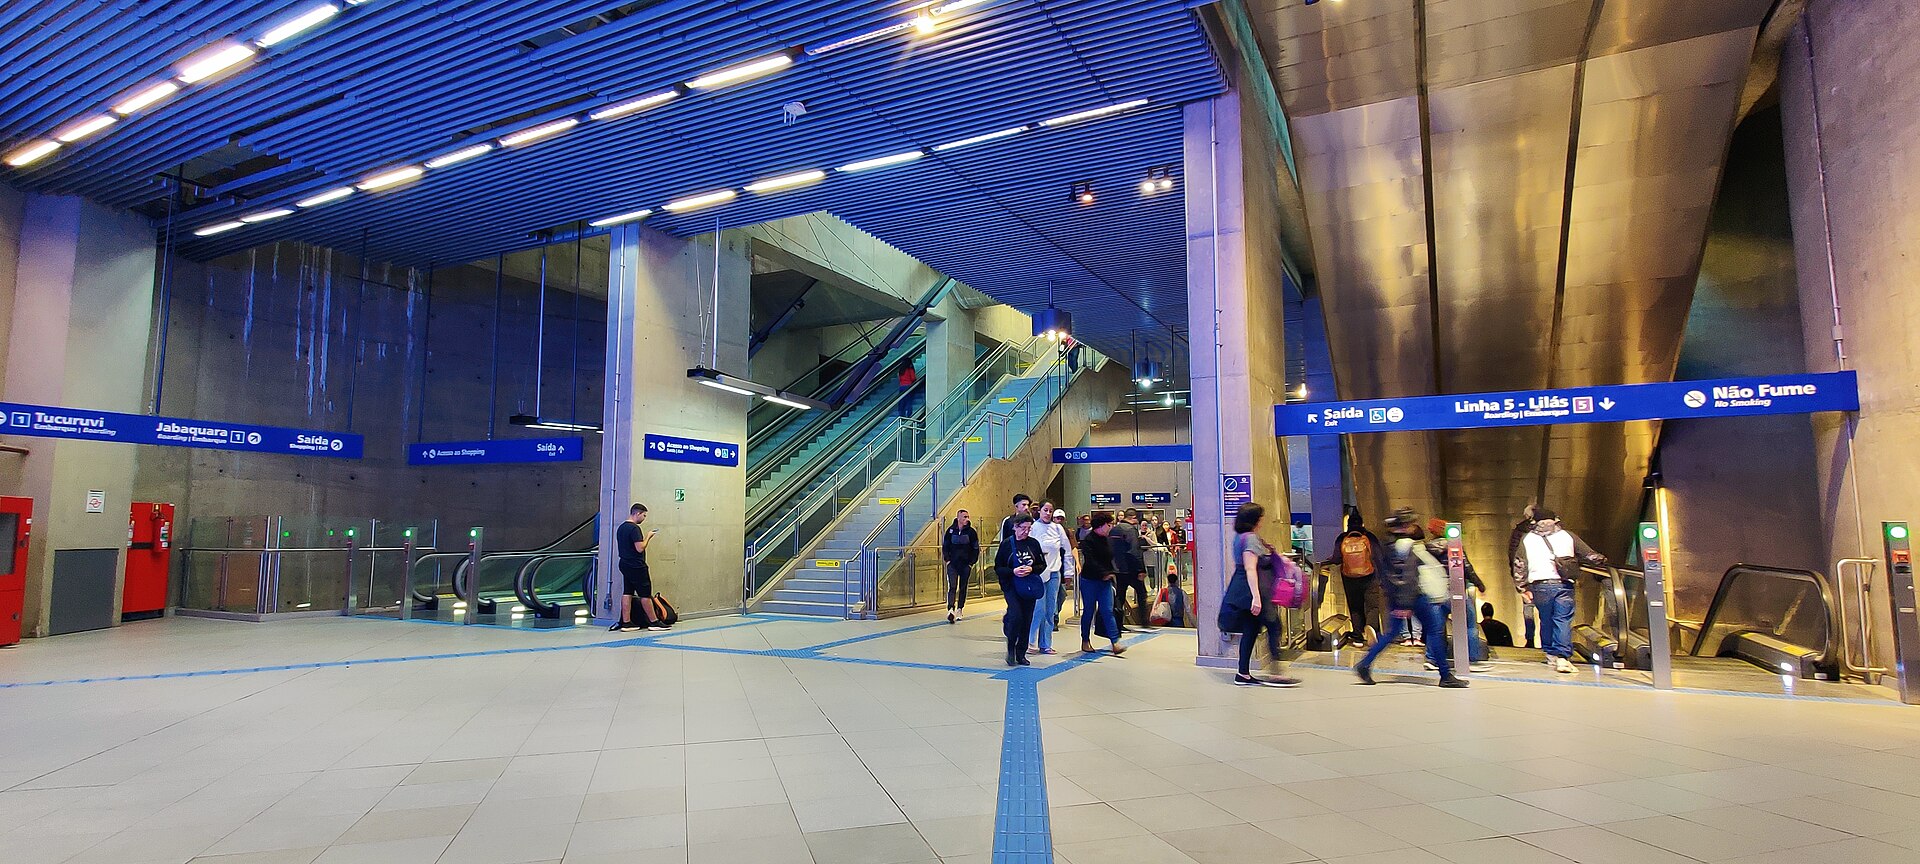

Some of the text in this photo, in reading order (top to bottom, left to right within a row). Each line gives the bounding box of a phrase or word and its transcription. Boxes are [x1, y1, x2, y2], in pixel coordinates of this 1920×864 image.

[1712, 384, 1817, 399] Não Fume
[1455, 400, 1500, 413] Linha
[1504, 399, 1514, 411] 5
[1529, 396, 1569, 410] Lilás
[1578, 400, 1587, 410] 5
[1730, 399, 1771, 407] Smoking
[17, 412, 104, 428] 1 Tucuruvi
[1324, 407, 1363, 420] Saída
[34, 424, 77, 433] Embarque
[156, 422, 241, 441] Jabaquara 1
[297, 435, 328, 446] Saída
[537, 443, 556, 452] Saída
